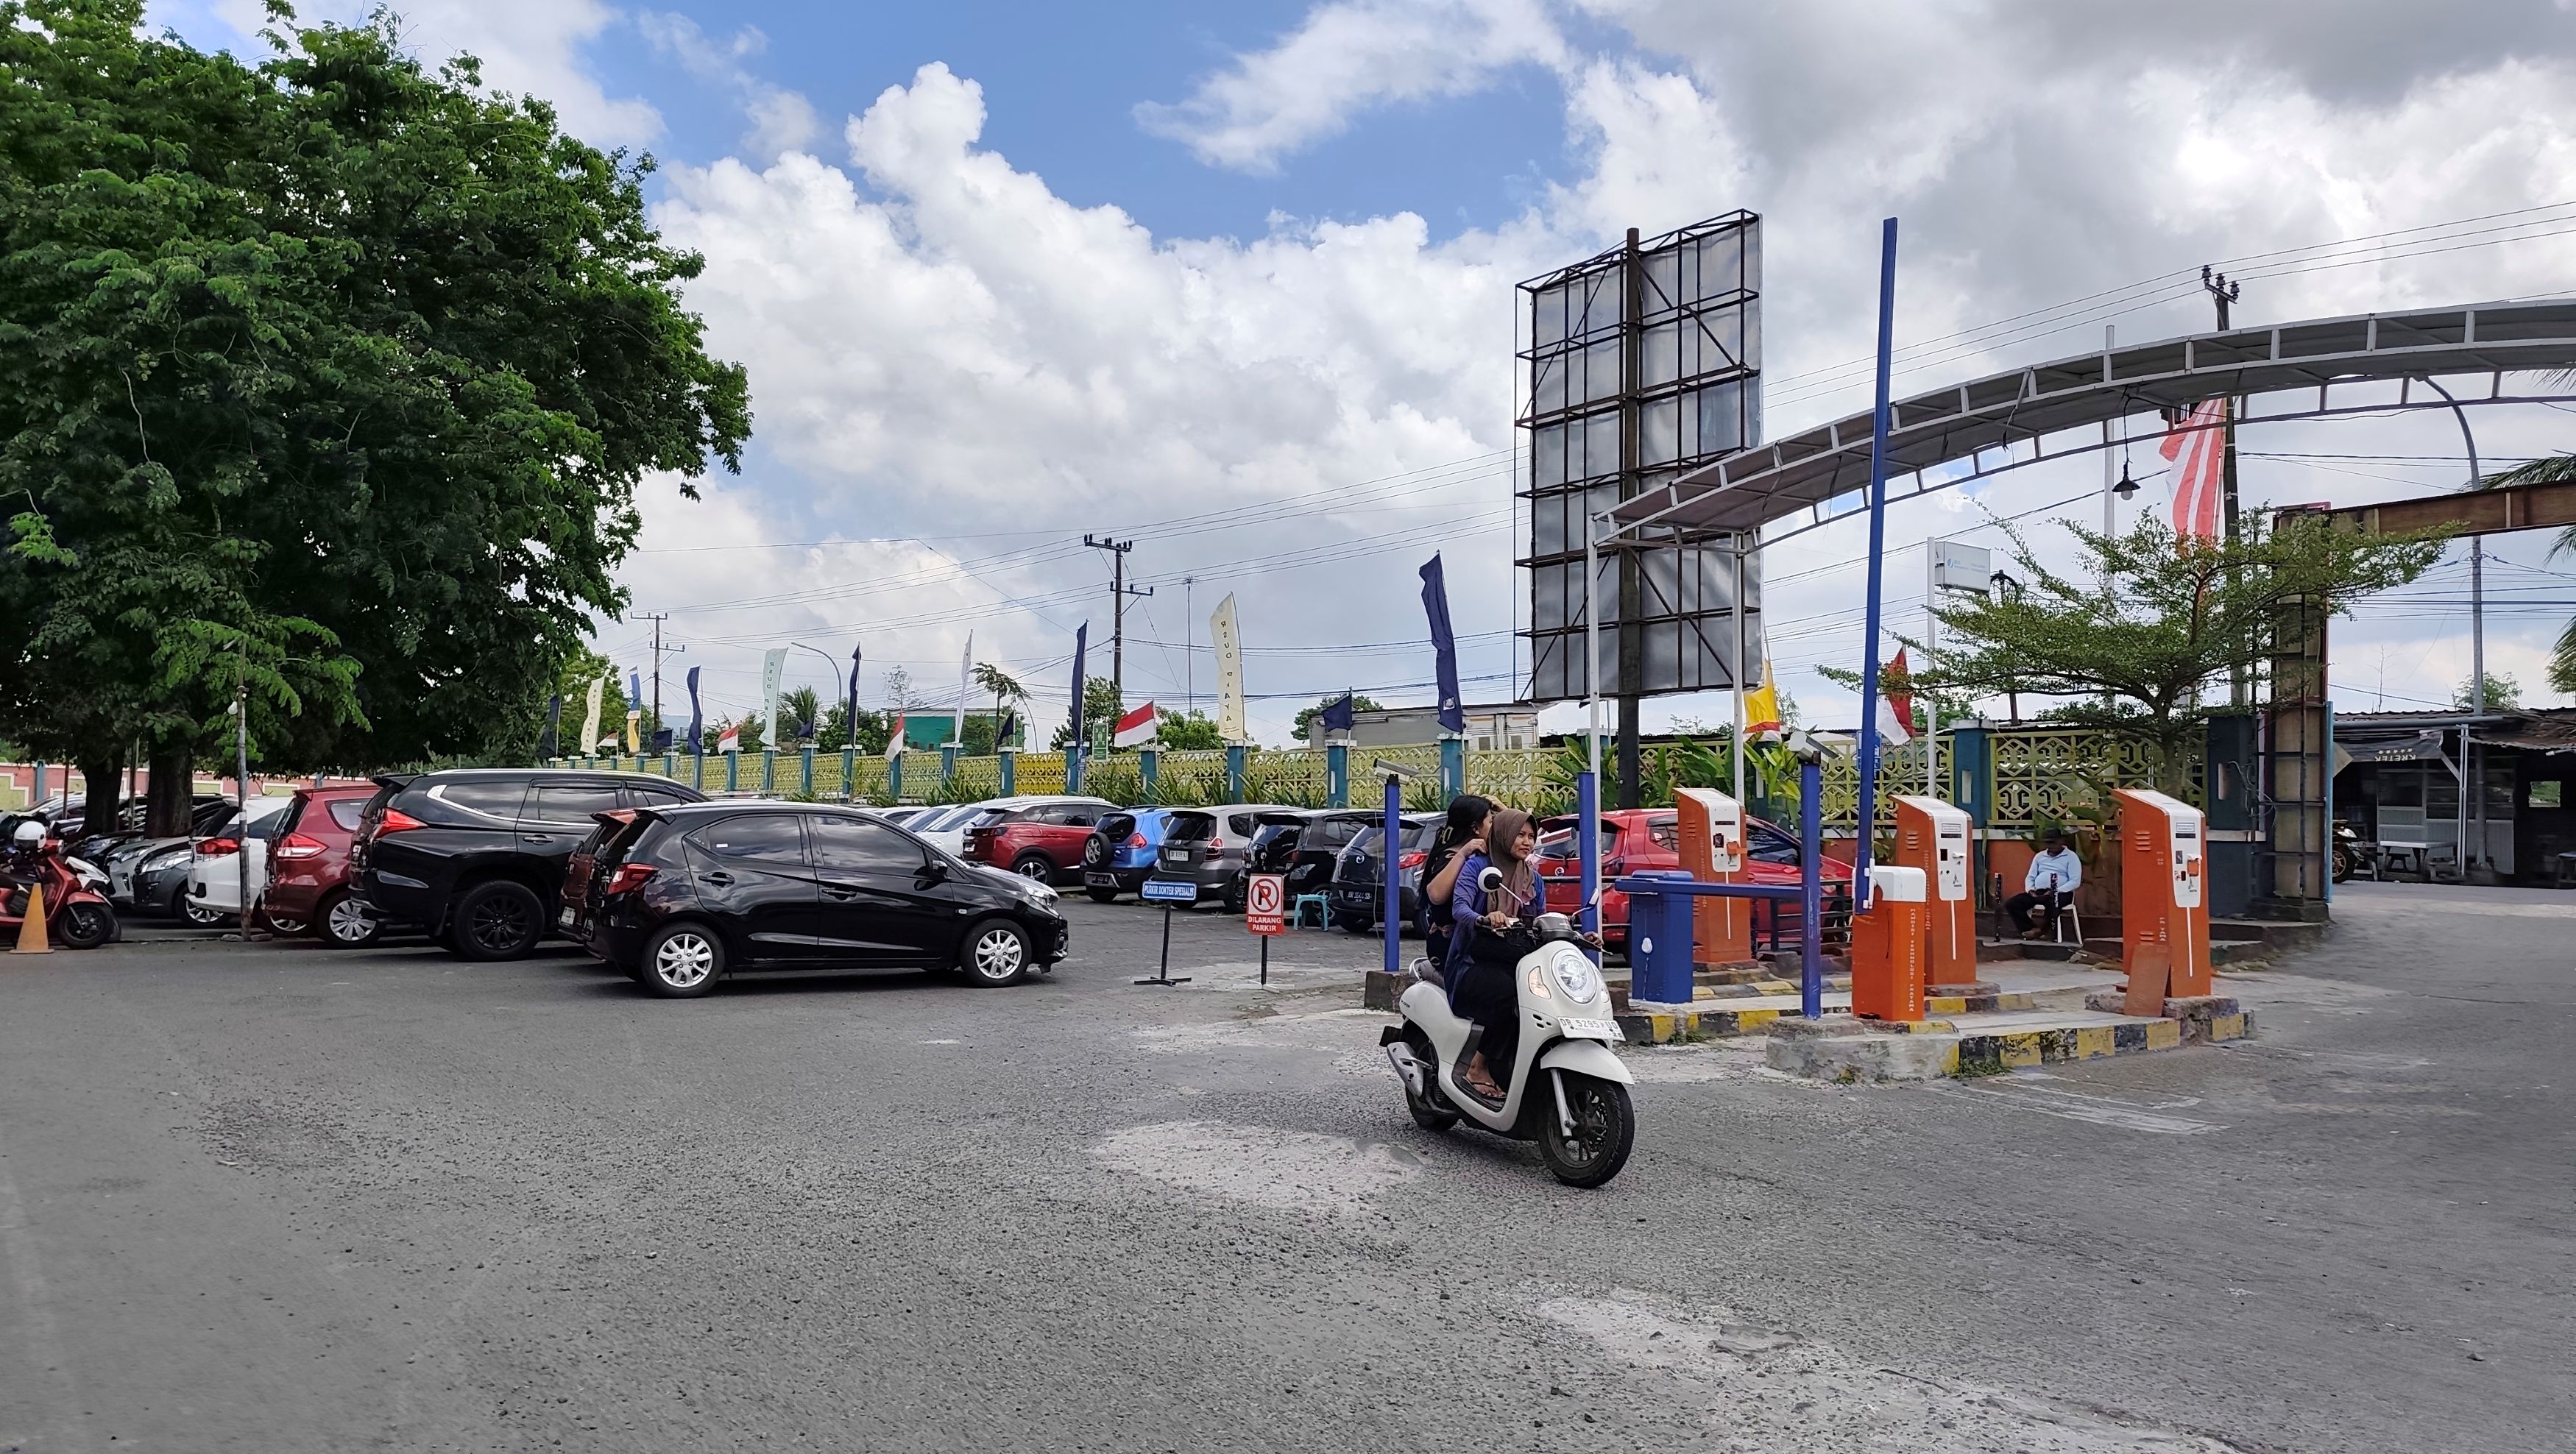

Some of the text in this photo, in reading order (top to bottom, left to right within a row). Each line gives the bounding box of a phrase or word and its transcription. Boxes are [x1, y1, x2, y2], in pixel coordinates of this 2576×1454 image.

[1144, 884, 1195, 897] PARKIR DOKTER SPESIALIS
[1560, 1018, 1574, 1026] DR
[1575, 1020, 1600, 1029] 5295
